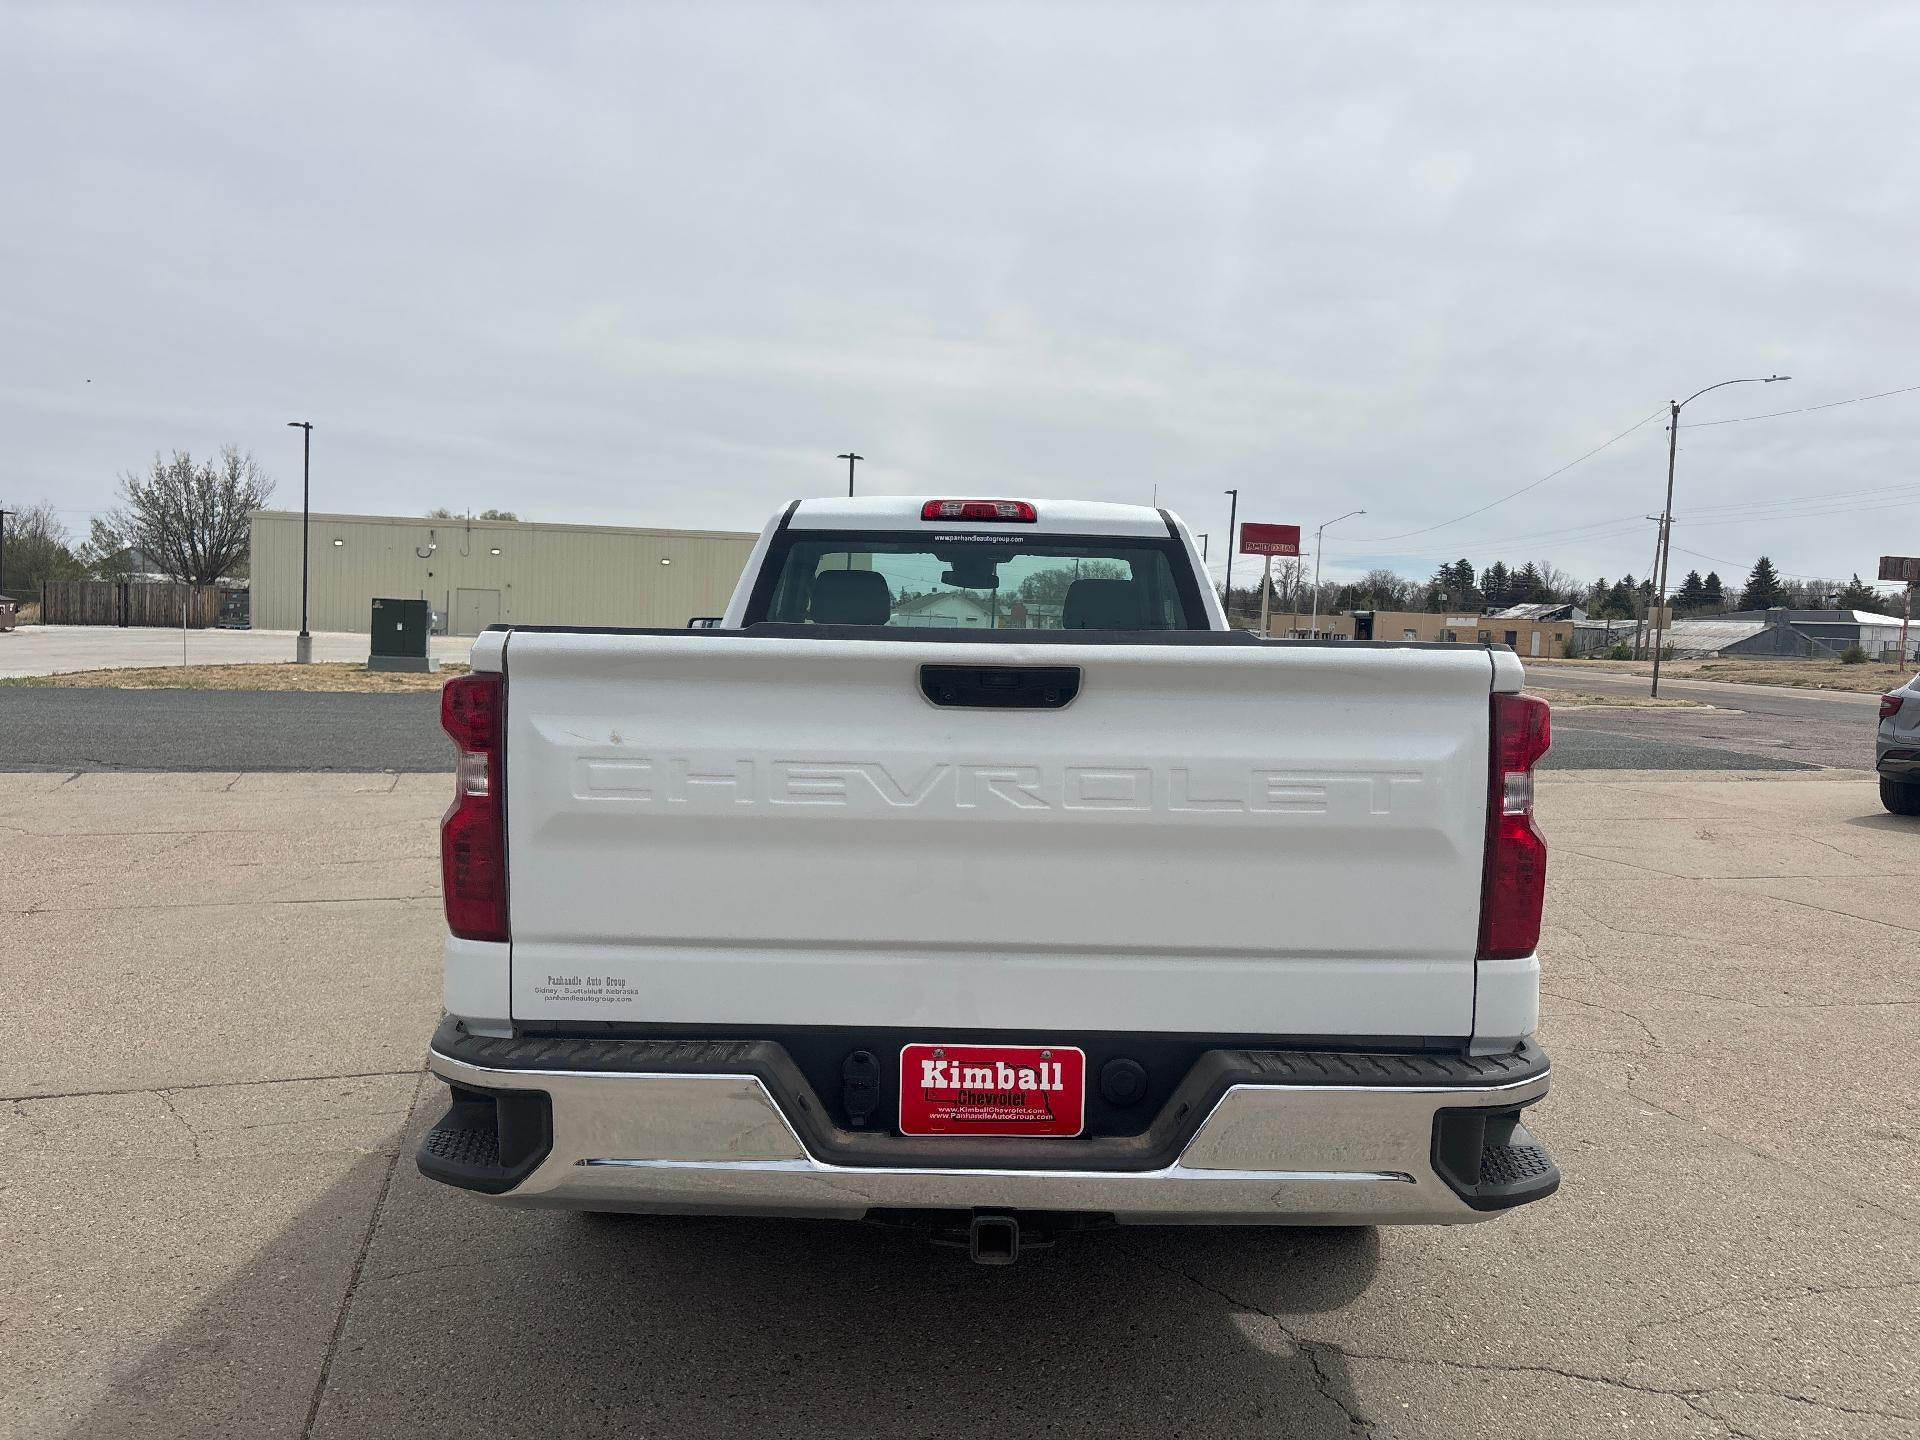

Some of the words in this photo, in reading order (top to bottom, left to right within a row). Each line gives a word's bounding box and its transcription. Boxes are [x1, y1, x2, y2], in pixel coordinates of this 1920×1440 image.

[934, 535, 1024, 544] www.panhandleautogroup.com
[1245, 541, 1270, 552] FAMILY
[572, 756, 1424, 815] CHEVROLET
[547, 975, 582, 986] Panhandle
[586, 976, 602, 986] Auto
[606, 976, 626, 988] Group
[605, 988, 639, 996] Nebraska
[920, 1059, 1064, 1091] Kimball
[957, 1089, 1027, 1107] Chevrolet
[938, 1106, 1046, 1114] www.KimballChevrolet.com
[929, 1112, 1054, 1121] www.PanhandleAutoGroup.com
